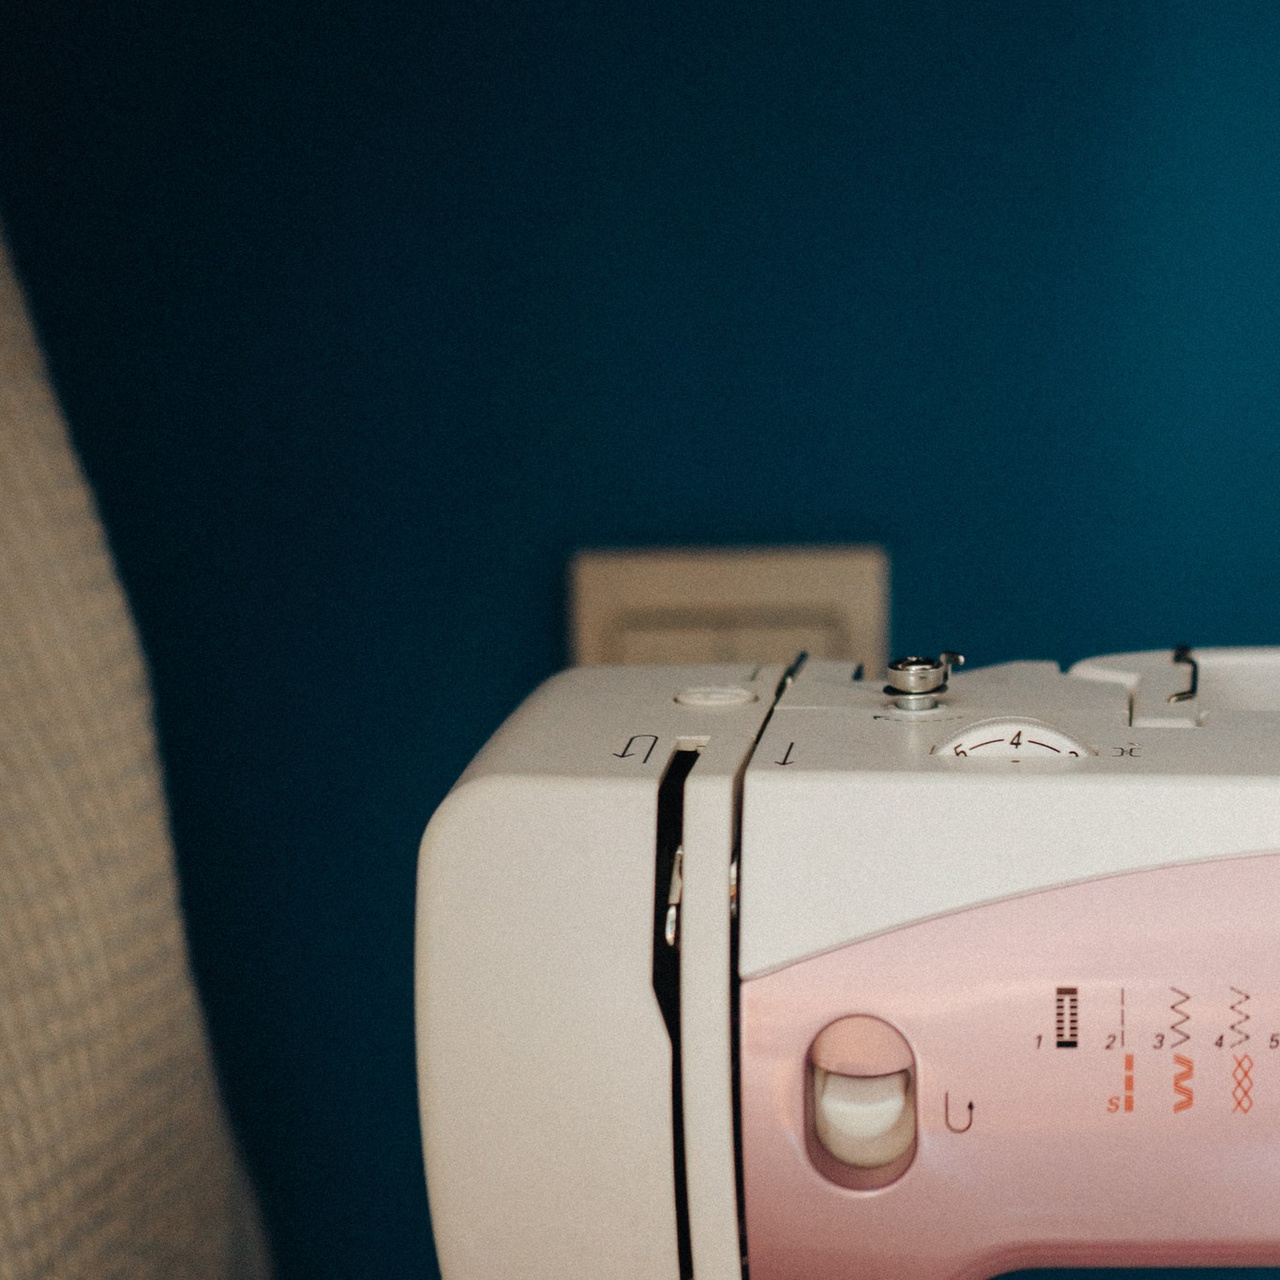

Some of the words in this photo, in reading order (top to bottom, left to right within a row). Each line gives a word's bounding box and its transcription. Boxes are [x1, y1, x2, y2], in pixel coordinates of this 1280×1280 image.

[1009, 730, 1022, 749] 4
[1035, 1034, 1043, 1049] 1
[1104, 1034, 1117, 1050] 2
[1152, 1033, 1165, 1050] 3
[1214, 1034, 1225, 1049] 4
[1269, 1033, 1280, 1050] 5
